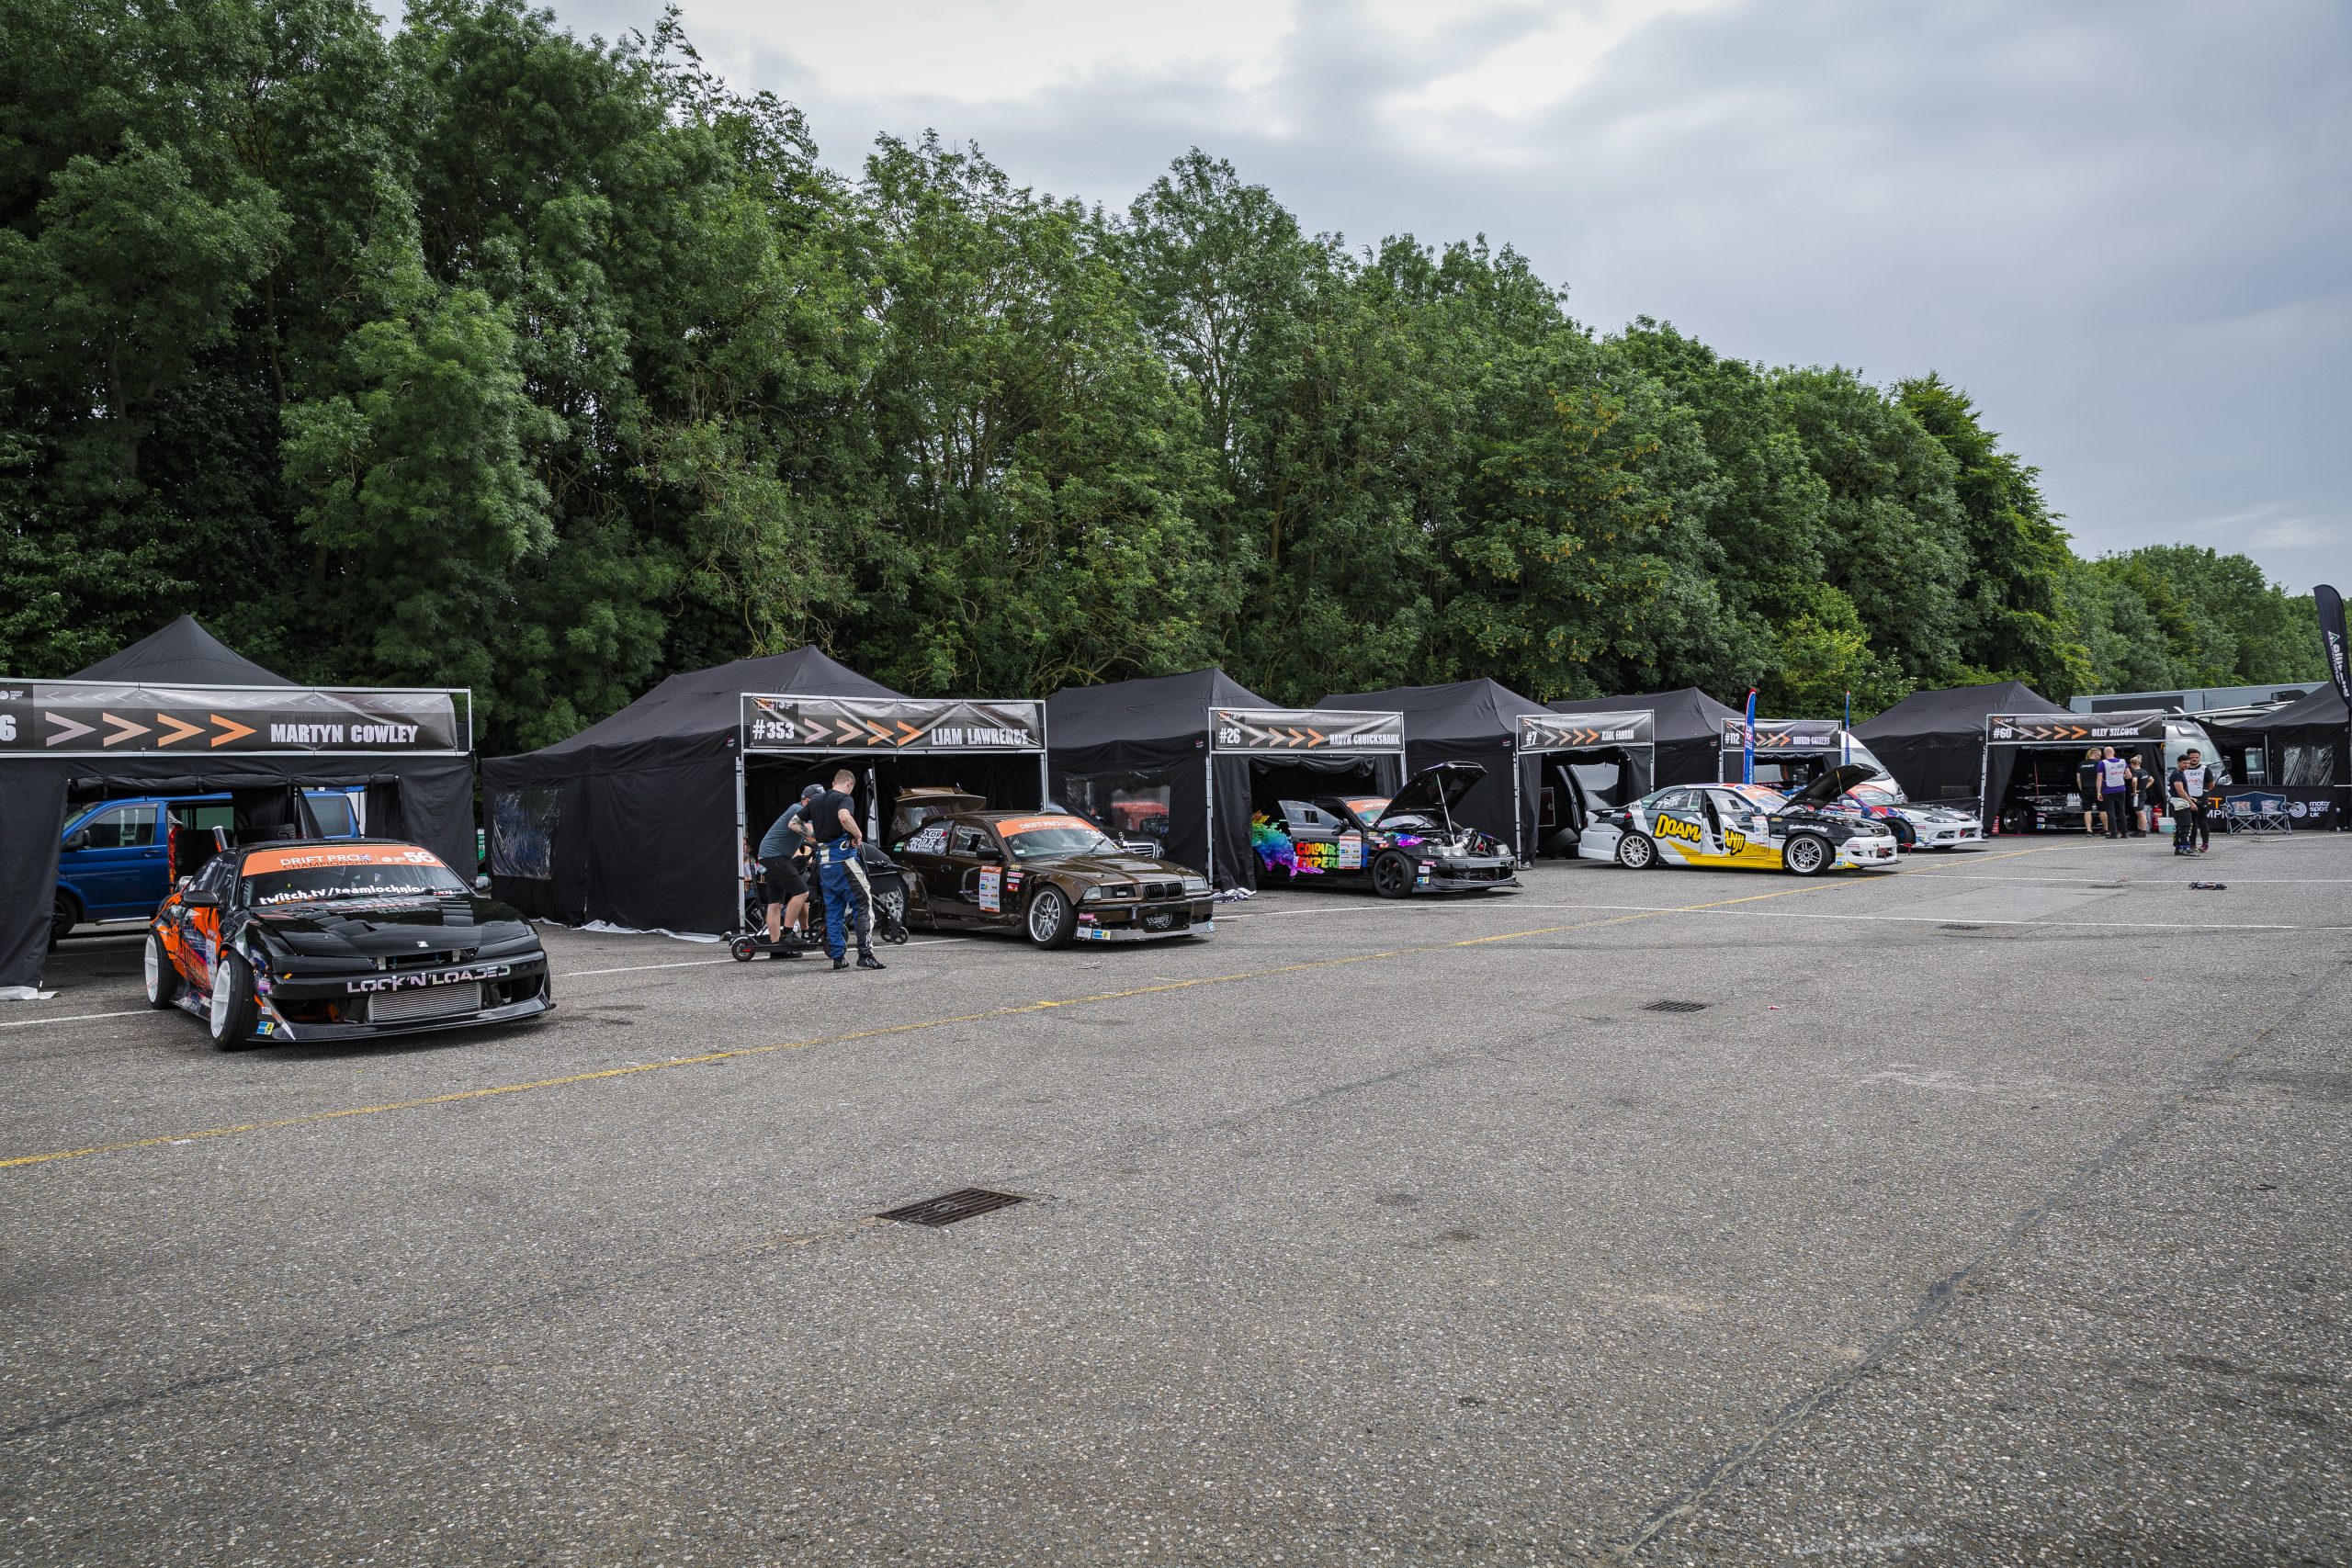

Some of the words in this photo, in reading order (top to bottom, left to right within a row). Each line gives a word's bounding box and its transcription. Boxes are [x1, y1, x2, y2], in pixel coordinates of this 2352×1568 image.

[270, 724, 344, 743] MARTYN
[350, 725, 419, 743] COWLEY
[752, 718, 795, 740] #353
[931, 728, 963, 746] LIAM
[967, 728, 1029, 745] LAWRENCE
[1218, 727, 1241, 744] #26
[1992, 728, 2012, 739] #60
[1525, 730, 1538, 745] #7
[1724, 732, 1740, 745] #112
[1654, 814, 1702, 841] DOAM
[279, 855, 324, 866] DRIFT
[326, 852, 361, 862] PRO
[402, 852, 436, 863] 56
[283, 859, 373, 870] CHAMPIONSHIP
